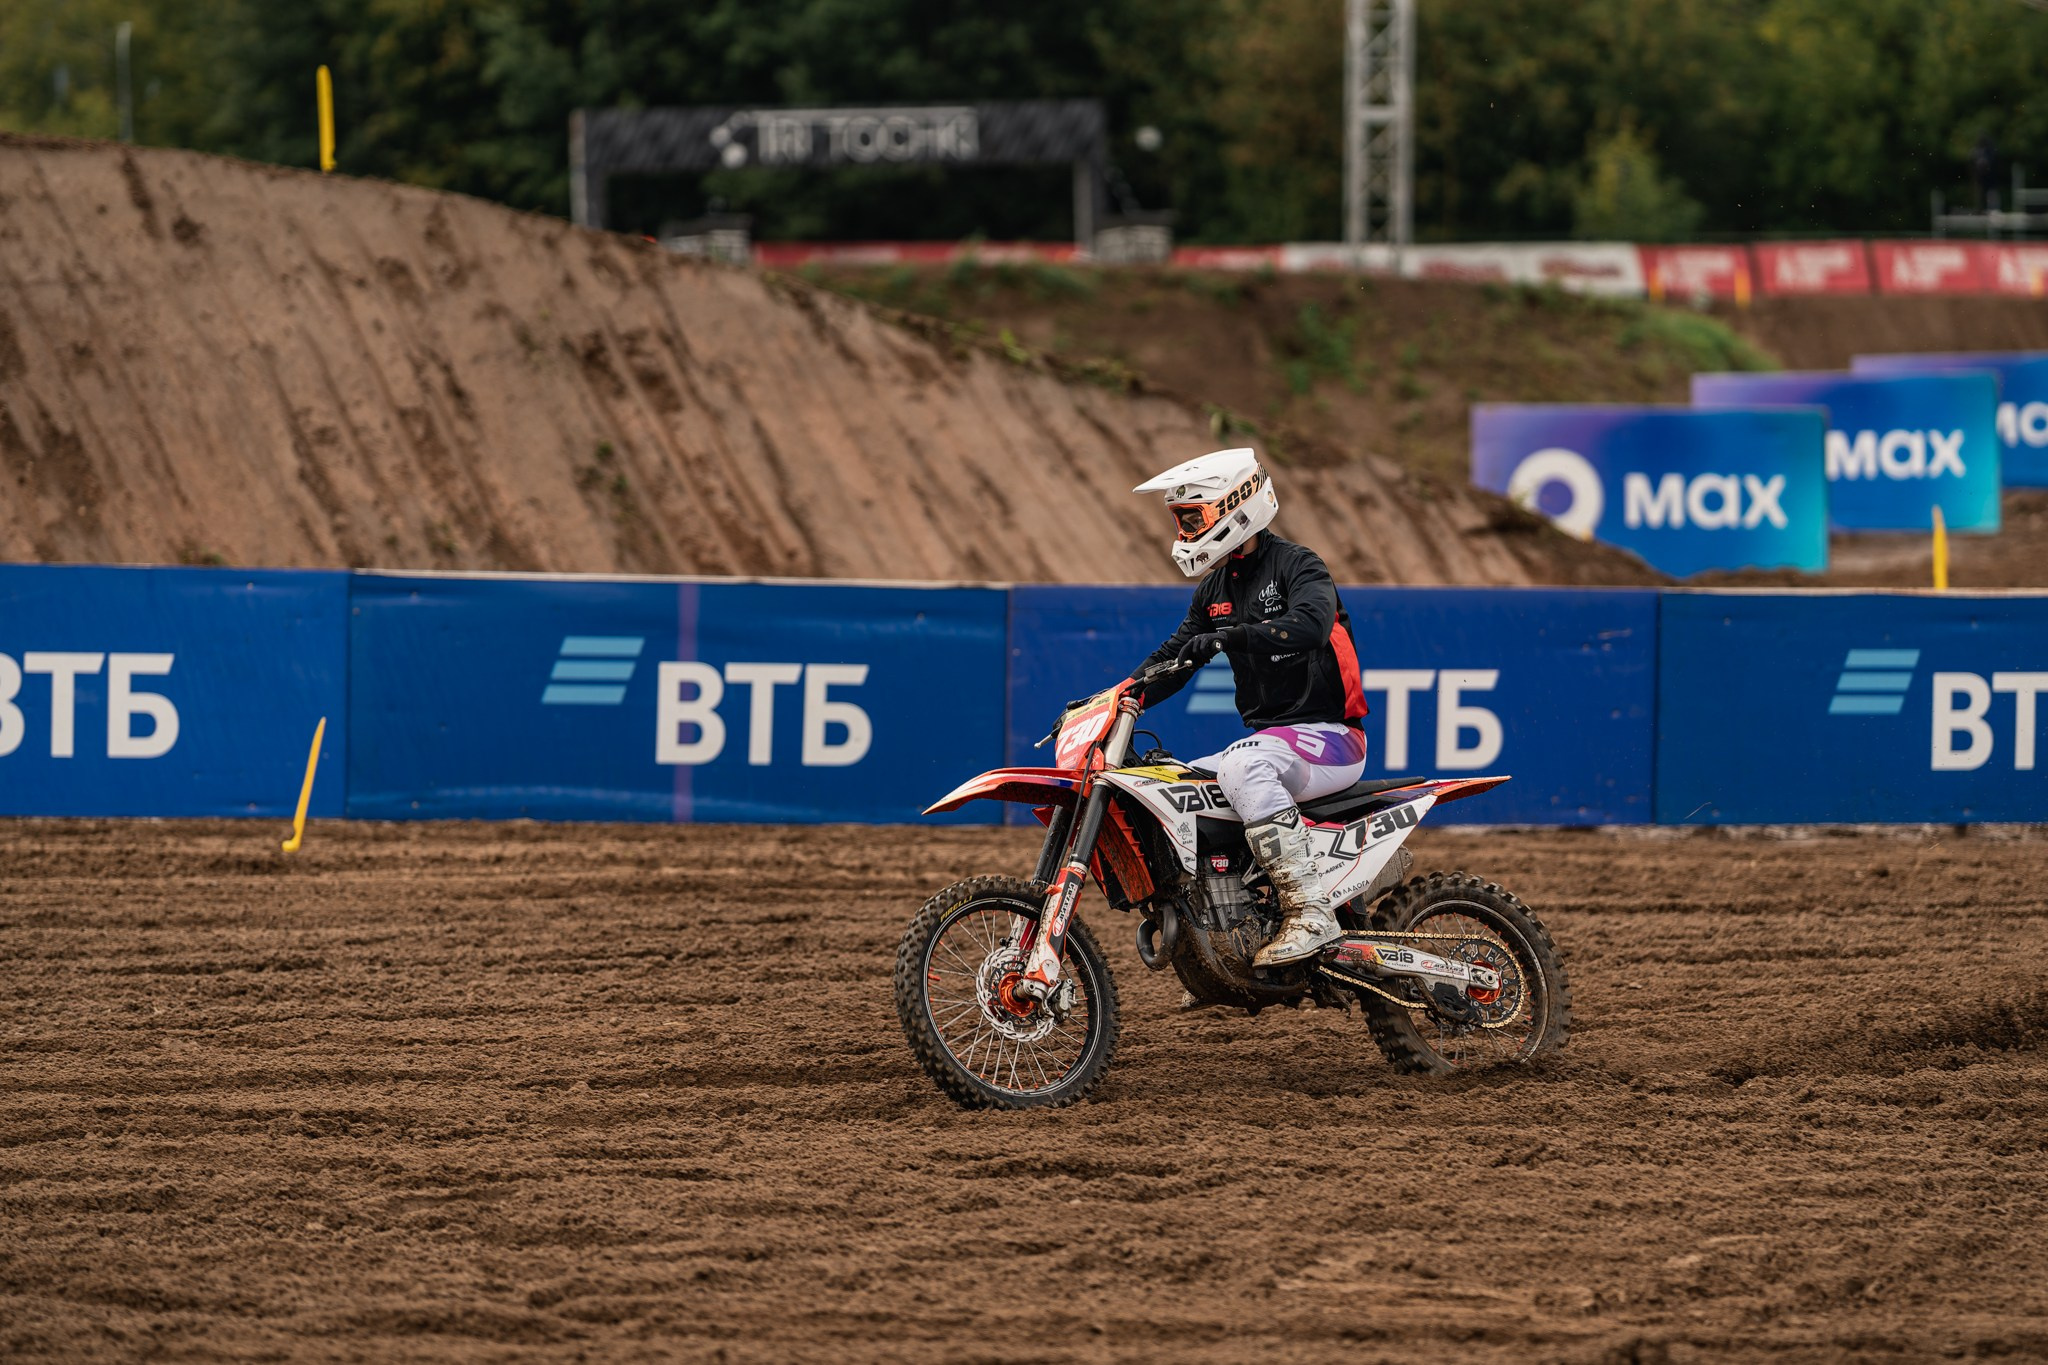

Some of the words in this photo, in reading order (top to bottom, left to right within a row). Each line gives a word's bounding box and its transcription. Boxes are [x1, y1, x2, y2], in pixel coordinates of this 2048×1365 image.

[655, 661, 873, 766] ВТБ
[1363, 669, 1504, 770] ТБ
[1056, 710, 1111, 762] 730
[1157, 784, 1232, 814] VB18
[1344, 804, 1419, 850] 730
[1211, 858, 1229, 868] 730
[940, 895, 972, 923] PIRELLI
[1375, 948, 1414, 964] VB18
